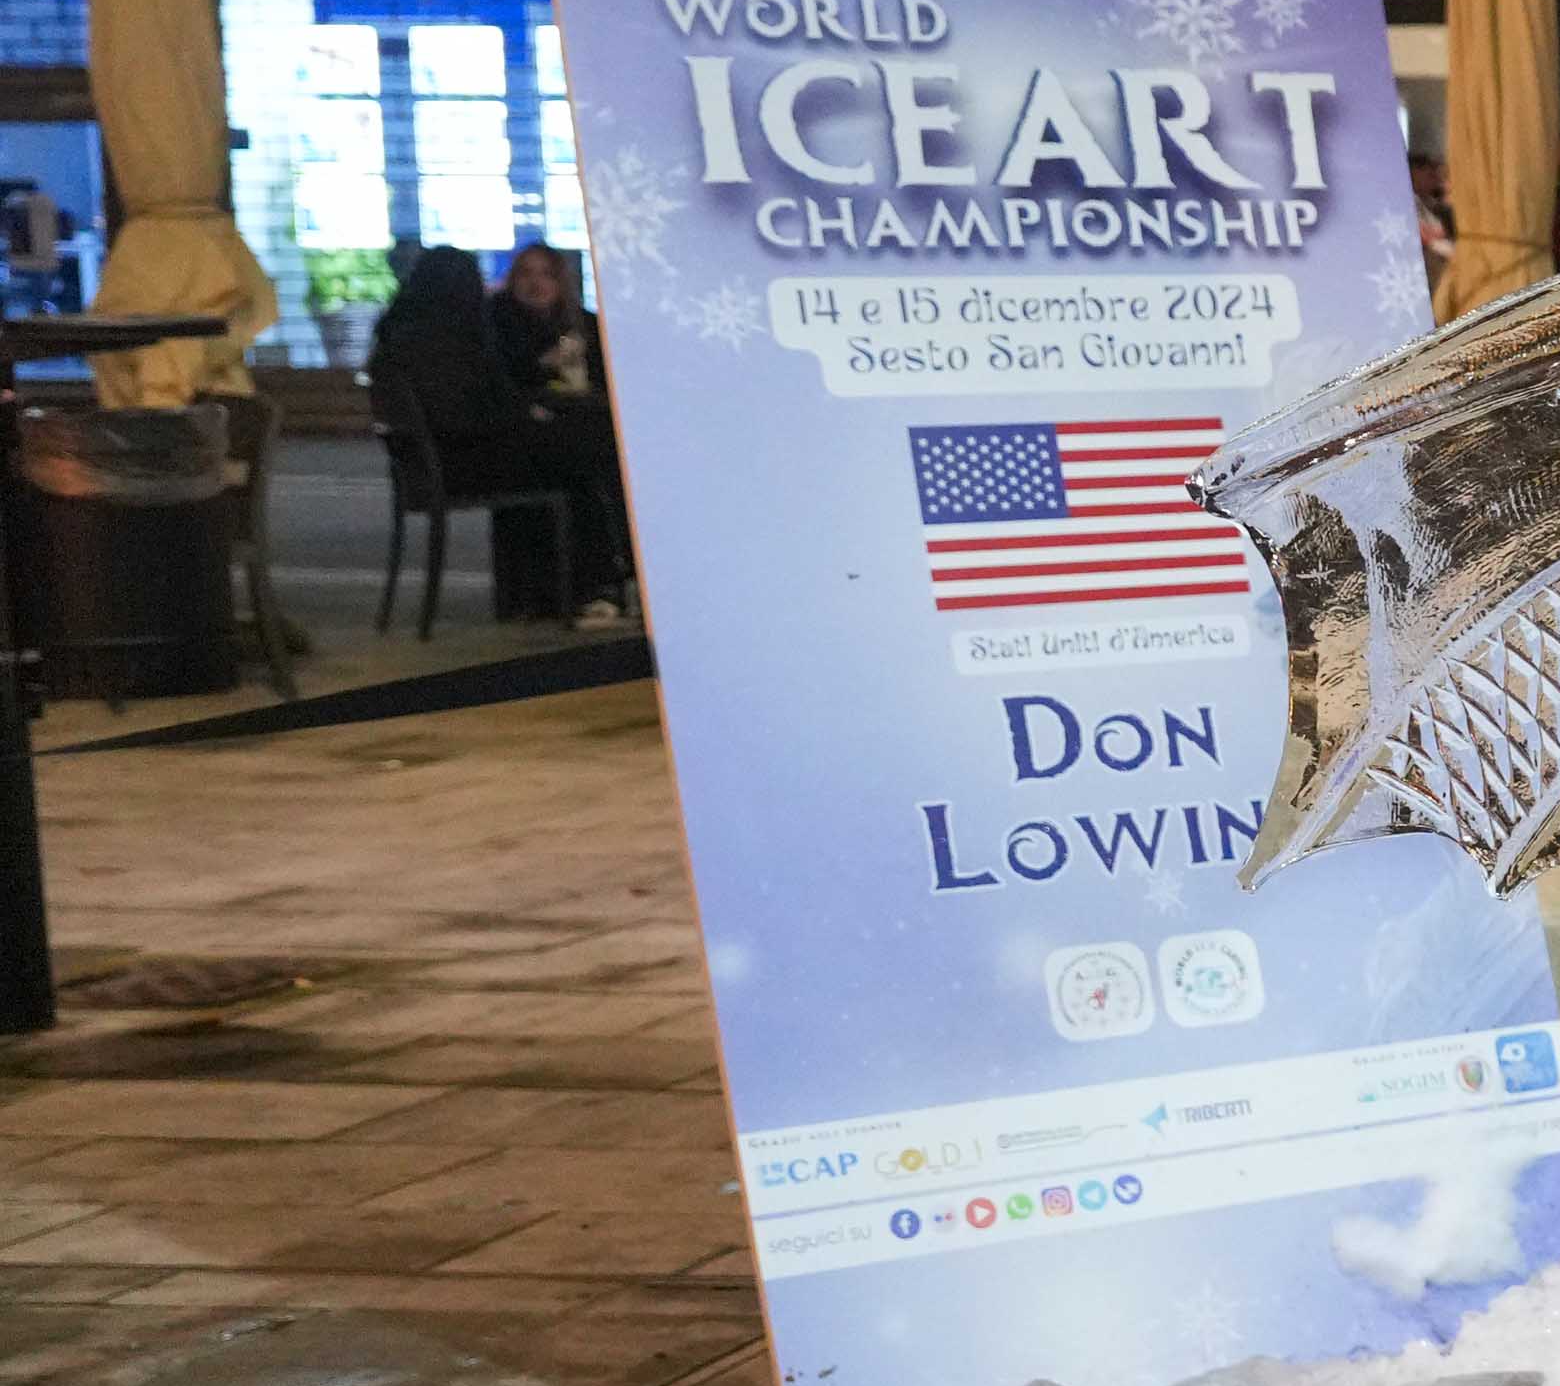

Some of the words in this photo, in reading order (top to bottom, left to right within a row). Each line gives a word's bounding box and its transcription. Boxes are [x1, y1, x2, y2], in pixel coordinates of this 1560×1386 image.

[755, 194, 1320, 250] CHAMPIONSHIP
[795, 287, 843, 326] 14
[860, 298, 883, 326] e
[898, 287, 941, 325] 15
[958, 285, 1151, 324] dicembre
[1162, 283, 1276, 322] 2024
[847, 333, 971, 374] Sesto
[986, 332, 1065, 373] San
[1079, 332, 1248, 370] Giovanni
[921, 800, 1264, 890] LOWIN
[788, 1152, 860, 1185] CAP
